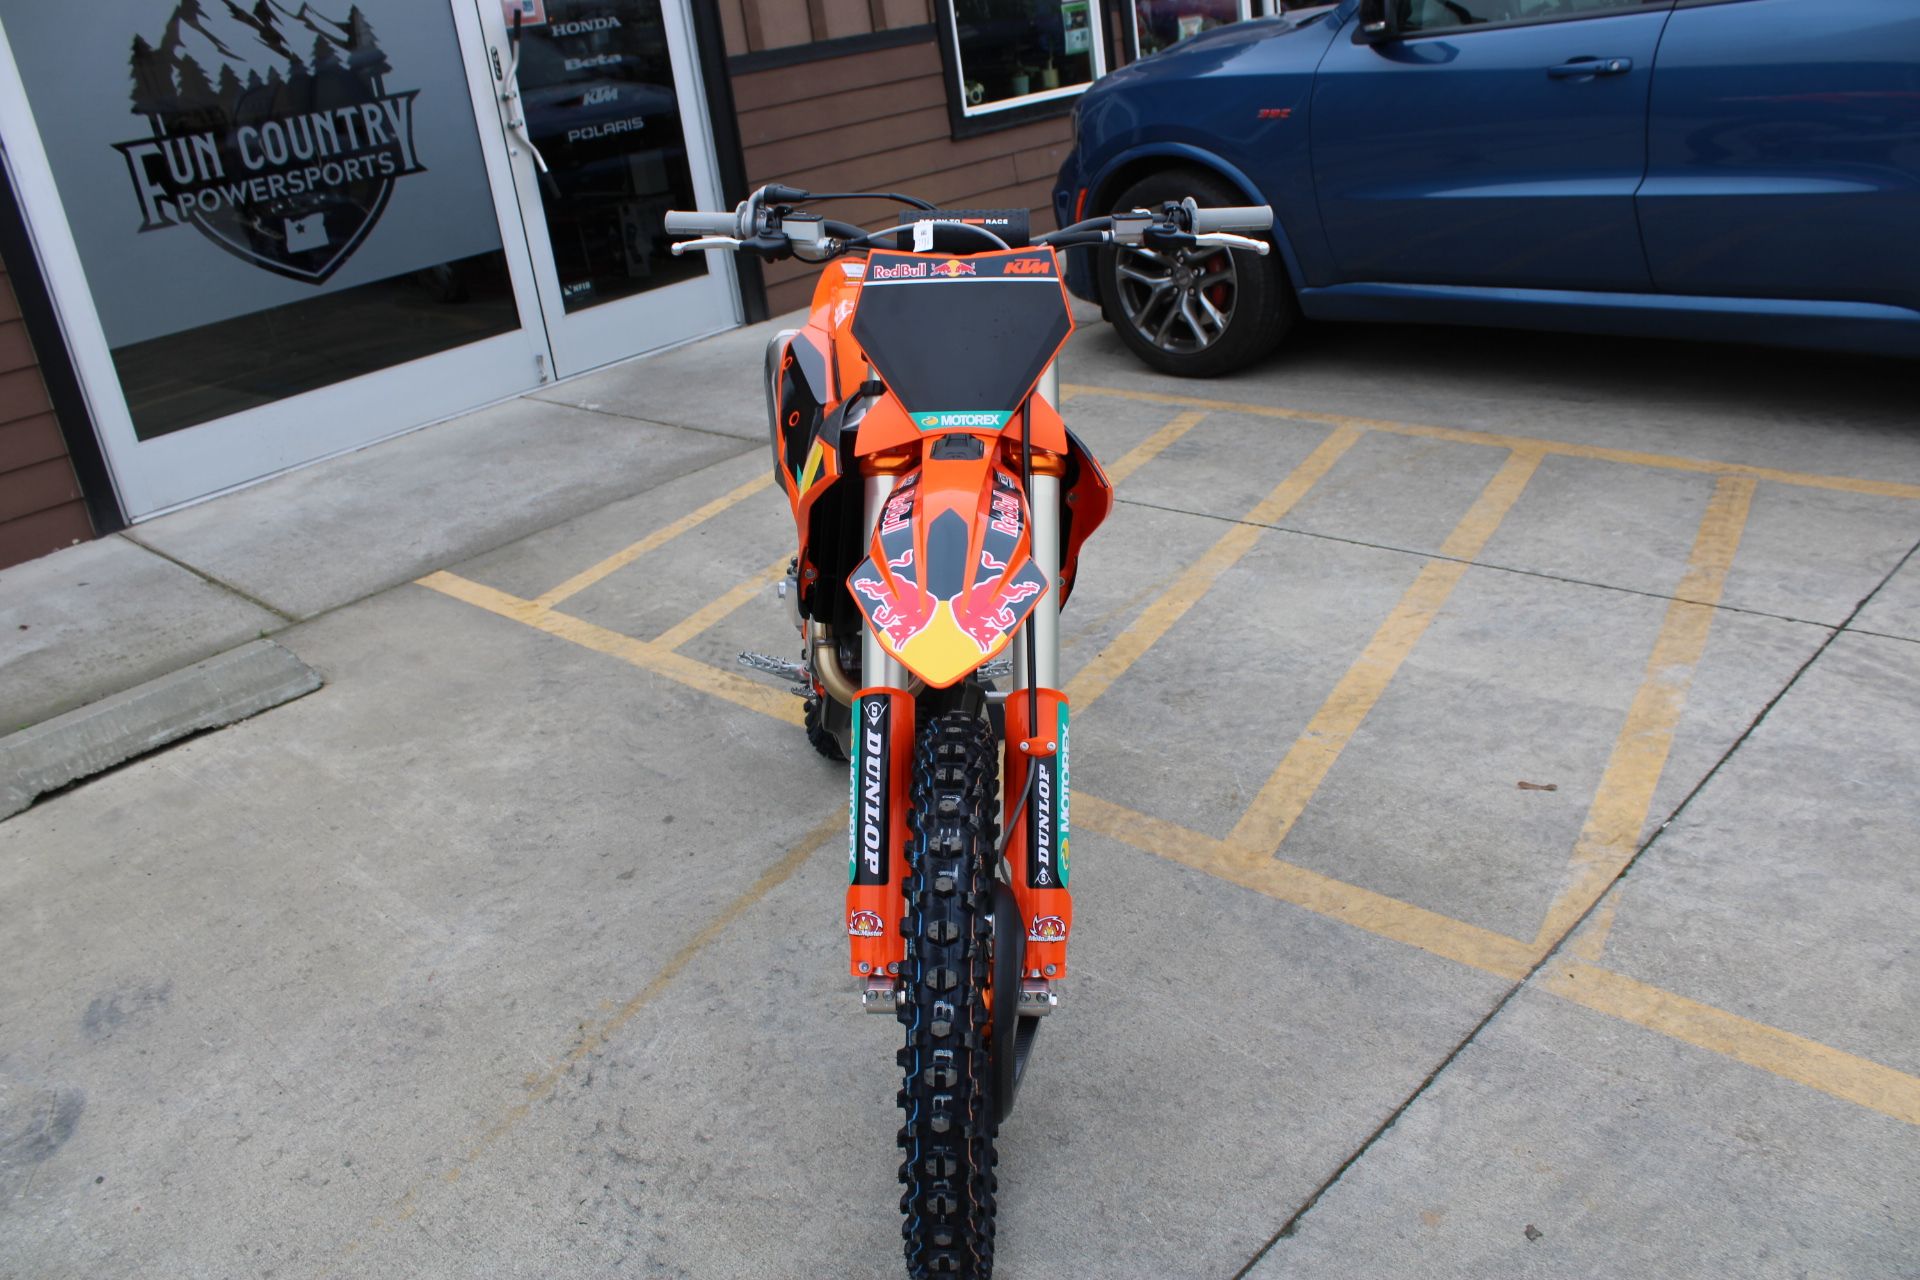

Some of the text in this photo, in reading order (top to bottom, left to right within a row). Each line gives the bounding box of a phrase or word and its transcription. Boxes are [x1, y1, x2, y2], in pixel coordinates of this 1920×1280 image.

[552, 16, 622, 37] HONDA
[564, 54, 622, 71] Beta
[583, 85, 619, 106] KTM
[568, 116, 644, 143] POLARIS
[127, 97, 415, 226] FUN COUNTRY
[177, 151, 396, 217] POWERSPORTS
[1003, 258, 1050, 274] KTM
[941, 414, 1000, 426] MOTOREX
[864, 728, 882, 875] DUNLOP
[1038, 763, 1050, 866] DUNLOP
